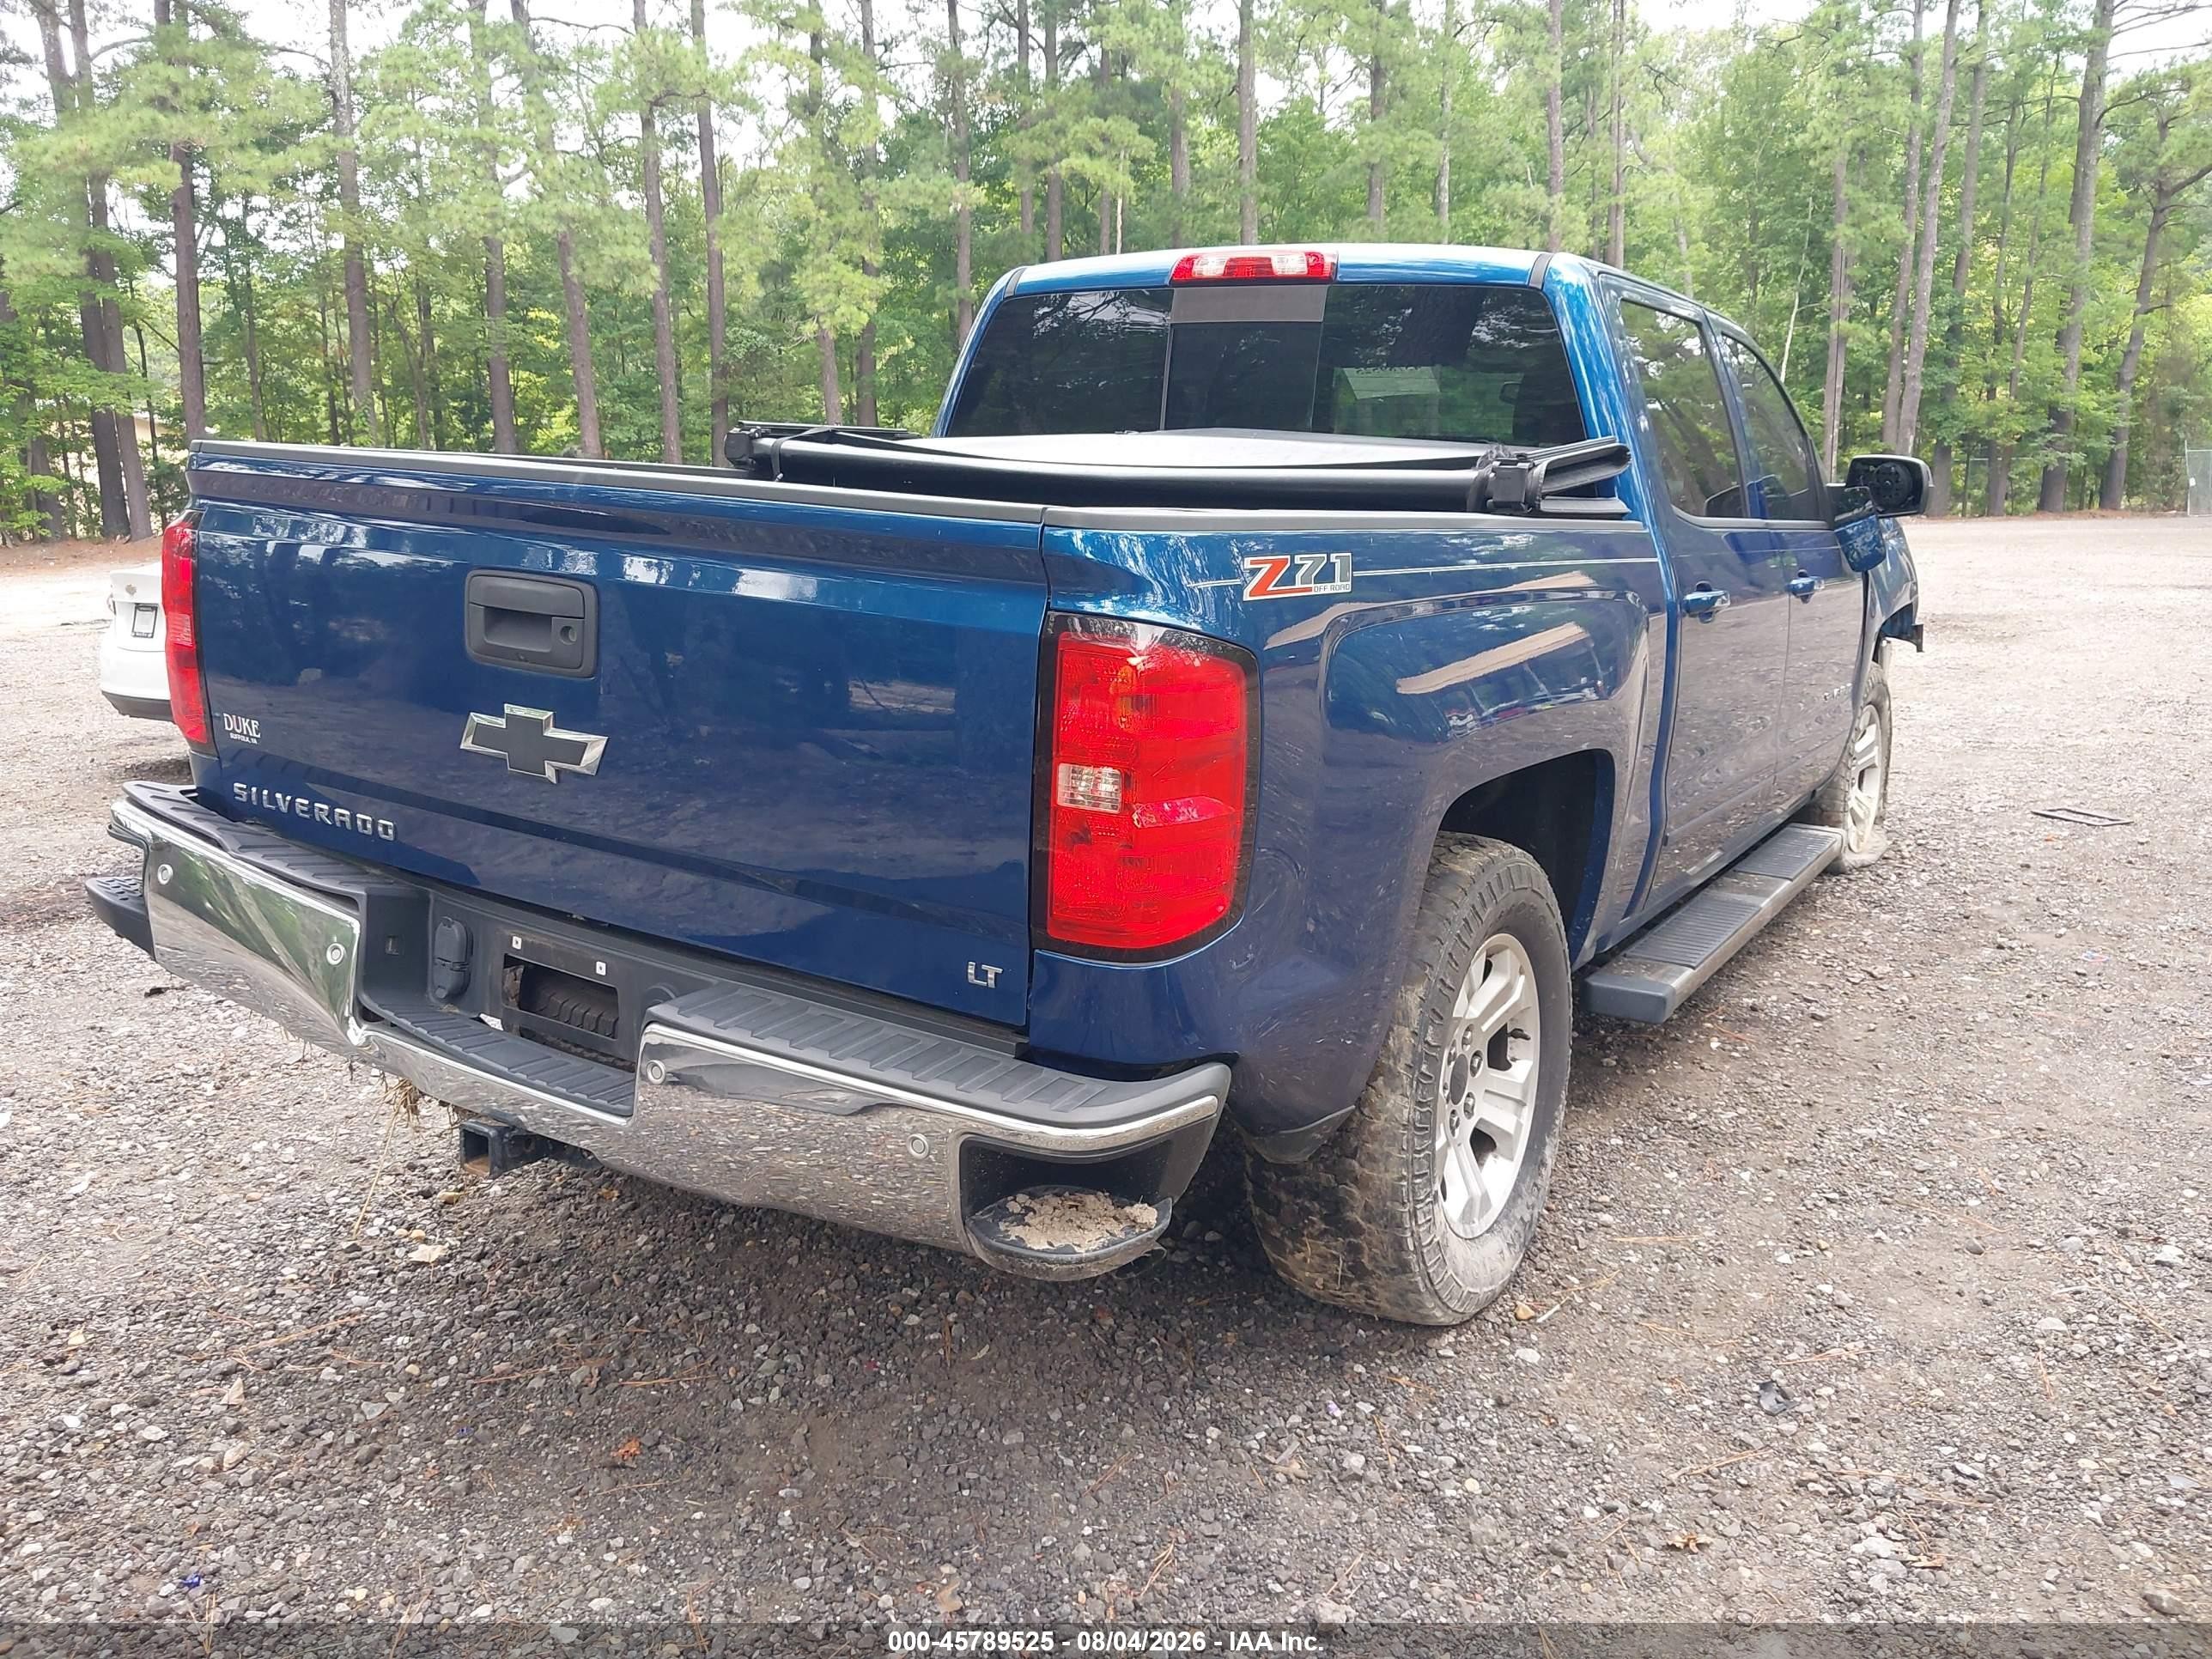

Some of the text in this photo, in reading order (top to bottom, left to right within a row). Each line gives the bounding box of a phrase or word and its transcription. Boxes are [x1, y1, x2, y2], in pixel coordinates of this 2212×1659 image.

[1243, 553, 1352, 601] Z71
[1330, 583, 1350, 592] ROAD
[223, 713, 261, 738] DUKE
[233, 782, 395, 842] SILVERADO
[968, 961, 1003, 988] LT
